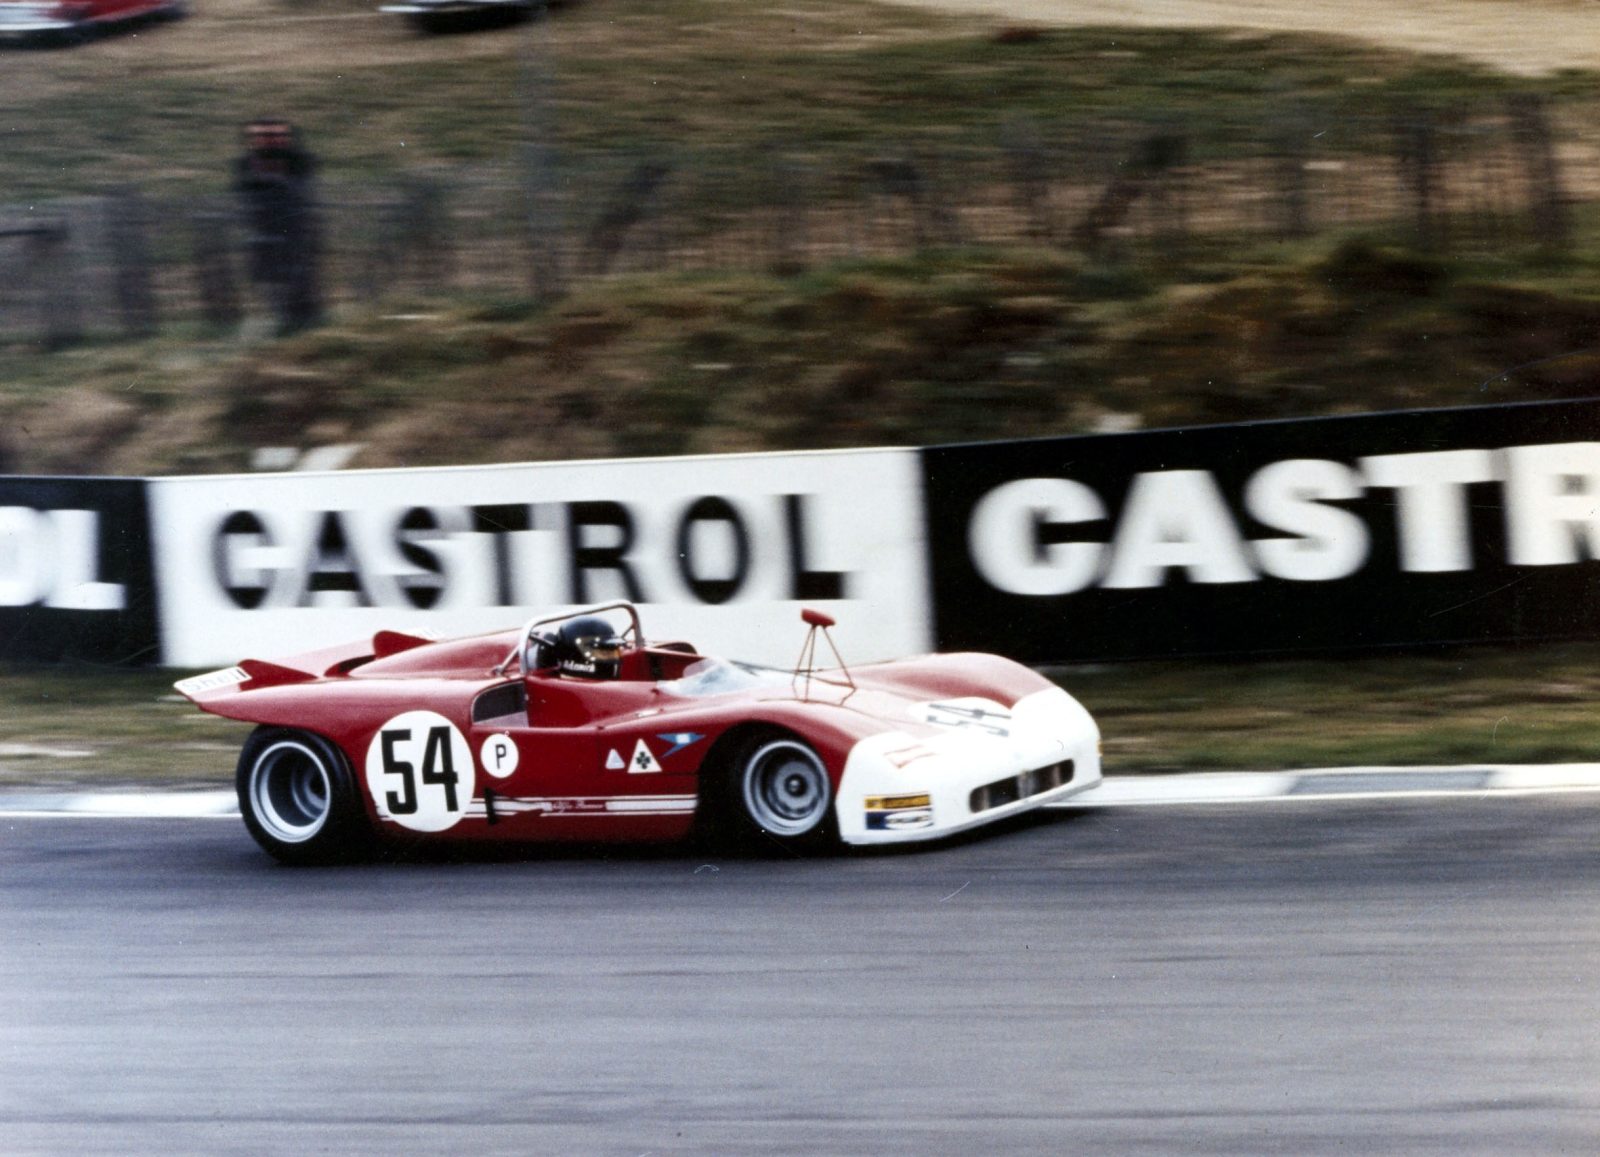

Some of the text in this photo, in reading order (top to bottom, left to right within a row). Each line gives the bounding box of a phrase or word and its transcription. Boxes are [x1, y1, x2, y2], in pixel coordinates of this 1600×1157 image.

[212, 494, 848, 609] CASTROL
[969, 442, 1600, 595] CASTR
[381, 726, 459, 815] 54
[495, 744, 507, 769] P
